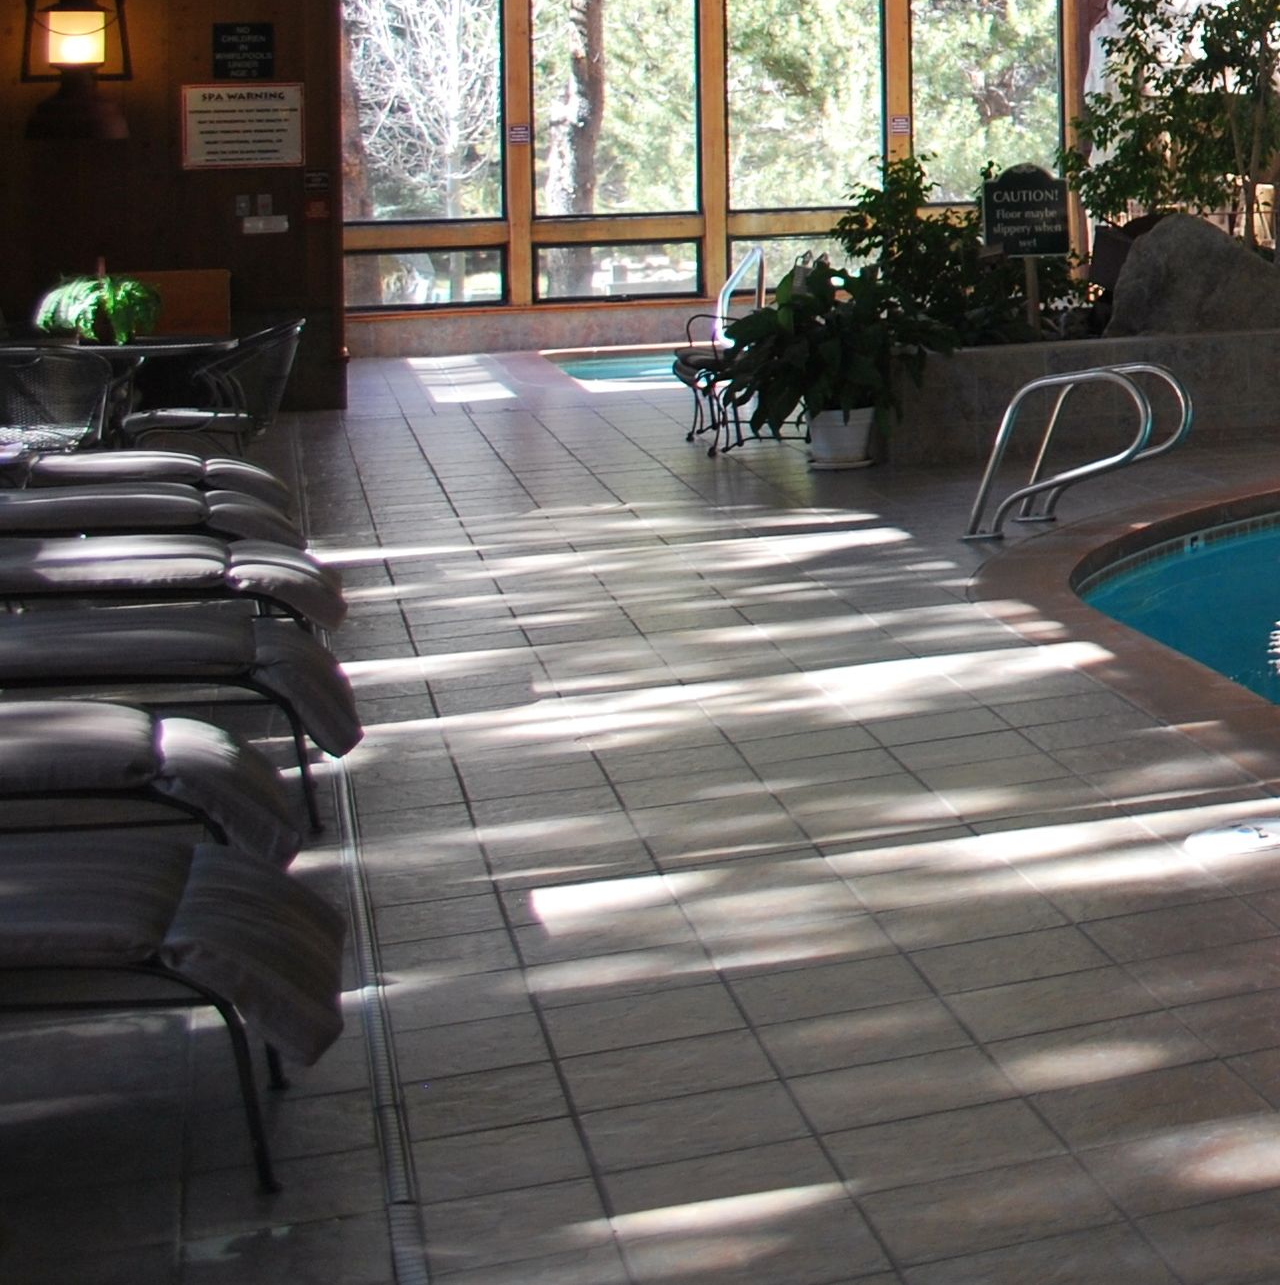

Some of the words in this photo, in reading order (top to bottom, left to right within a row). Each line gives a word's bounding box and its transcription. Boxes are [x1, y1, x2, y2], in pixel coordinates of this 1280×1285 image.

[236, 26, 250, 34] NO
[221, 35, 266, 43] CHILDREN
[201, 93, 224, 102] SPA
[227, 91, 285, 101] WARNING
[993, 189, 1058, 203] CAUTION!
[996, 208, 1021, 220] Floor
[1024, 206, 1057, 221] maybe
[992, 222, 1031, 236] slippery
[1033, 221, 1062, 233] when
[1018, 238, 1037, 247] wet
